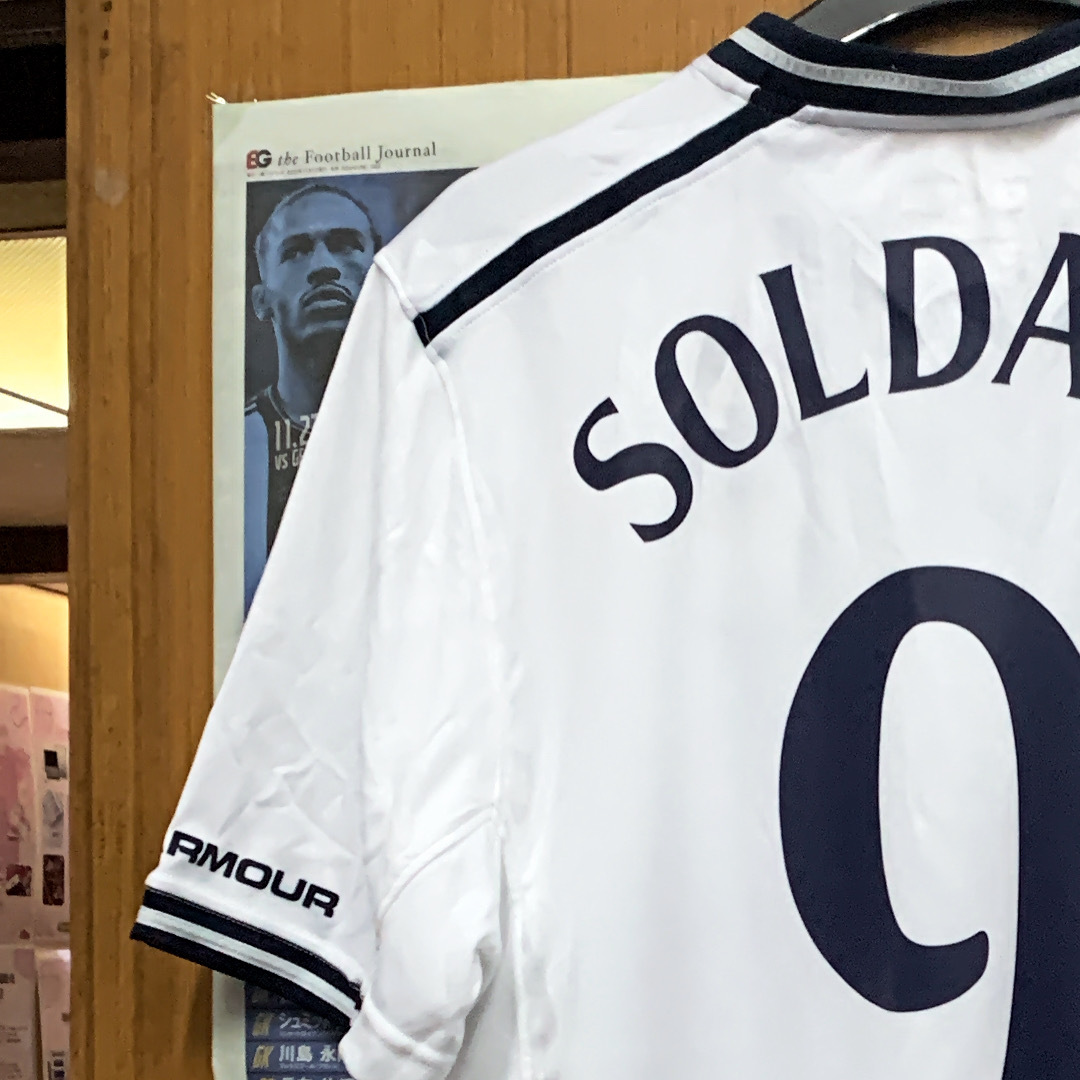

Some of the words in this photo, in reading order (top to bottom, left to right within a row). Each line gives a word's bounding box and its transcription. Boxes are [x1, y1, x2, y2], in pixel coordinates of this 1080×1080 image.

[278, 151, 298, 166] the
[305, 145, 371, 164] Football
[376, 141, 436, 164] Journal
[167, 830, 340, 918] RMOUR
[279, 1044, 313, 1062] 川島
